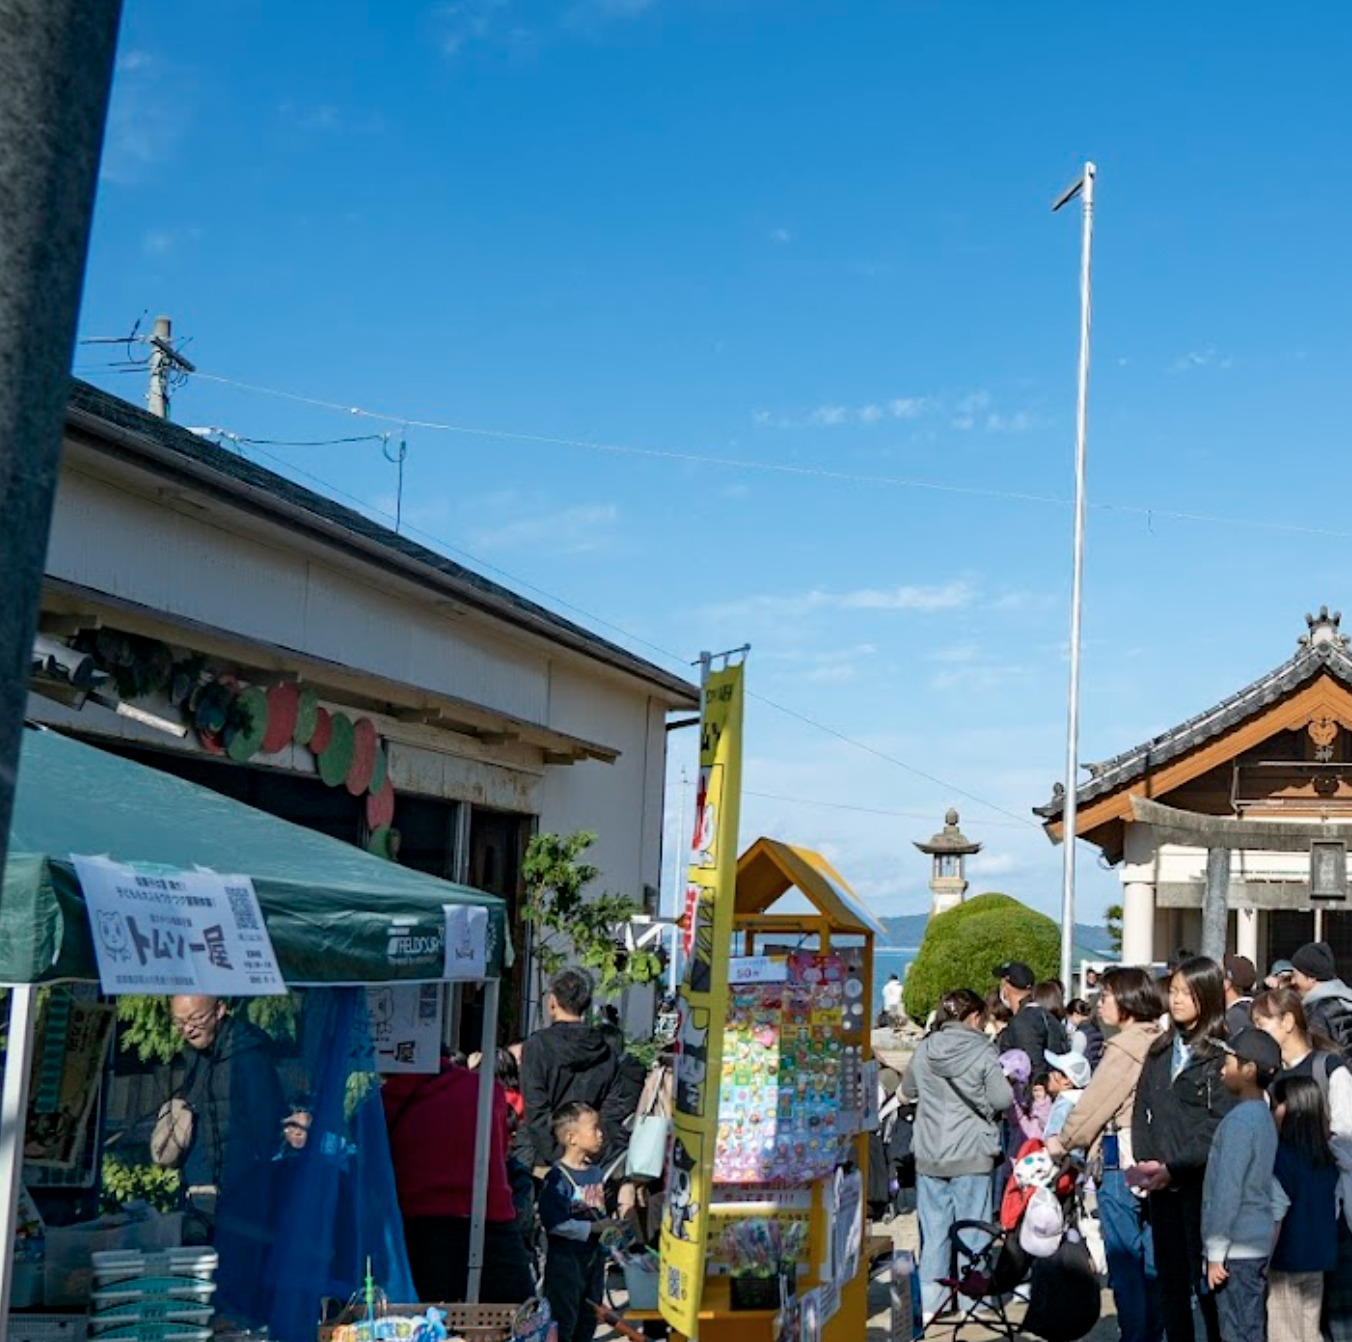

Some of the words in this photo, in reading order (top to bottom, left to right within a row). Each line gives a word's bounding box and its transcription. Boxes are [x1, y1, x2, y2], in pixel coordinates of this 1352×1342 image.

[125, 915, 234, 970] トムソー屋
